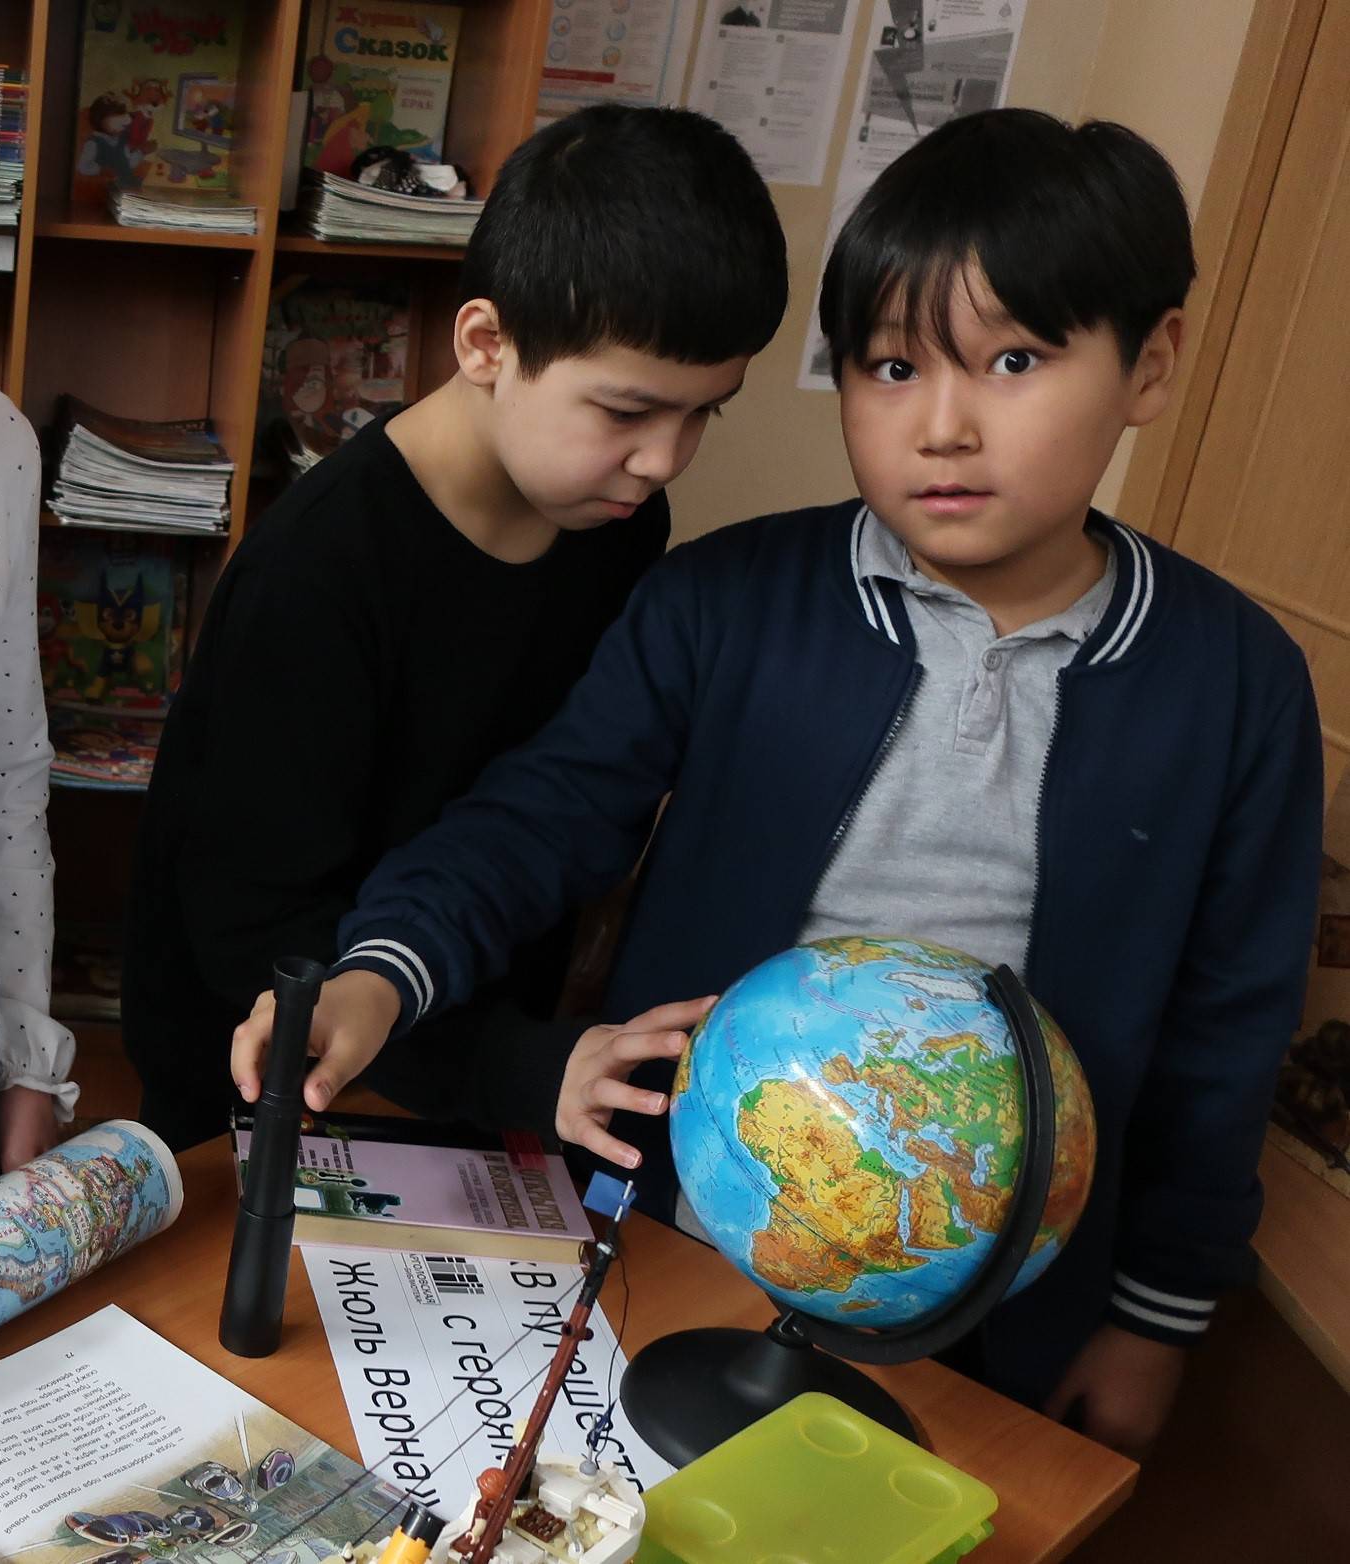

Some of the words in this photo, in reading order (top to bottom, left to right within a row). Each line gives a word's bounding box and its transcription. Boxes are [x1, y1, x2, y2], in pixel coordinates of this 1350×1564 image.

[334, 27, 449, 61] Сказок
[442, 1315, 477, 1330] с
[329, 1258, 385, 1356] Жюль
[362, 1366, 443, 1508] Верна»
[16, 1464, 38, 1476] этого
[3, 1492, 28, 1508] более
[31, 1486, 81, 1514] придумывать
[4, 1514, 30, 1534] новый
